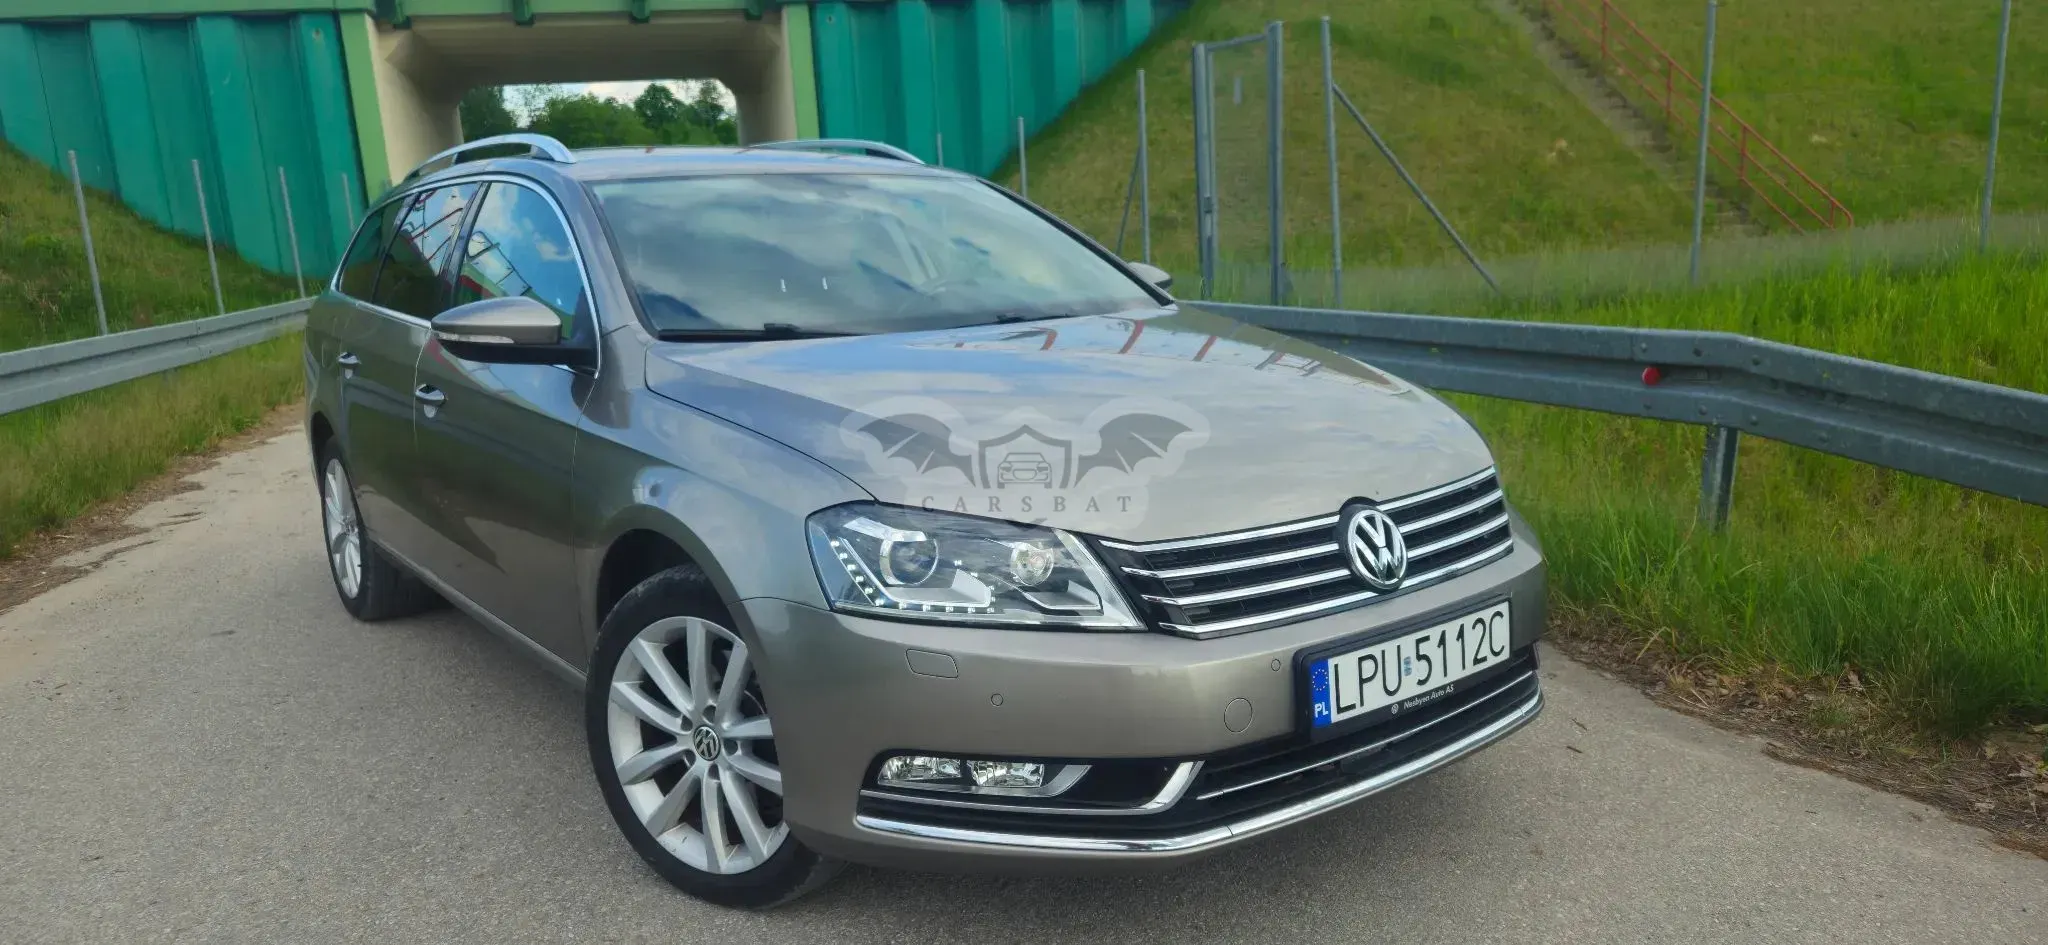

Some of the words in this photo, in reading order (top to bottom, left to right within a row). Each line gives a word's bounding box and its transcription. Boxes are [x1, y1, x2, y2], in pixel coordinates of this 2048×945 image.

[1348, 509, 1407, 585] VW
[1333, 644, 1402, 715] LPU
[1415, 610, 1505, 686] 5112C
[1314, 701, 1329, 718] PL
[1431, 691, 1445, 700] Auto
[1445, 684, 1454, 693] AS
